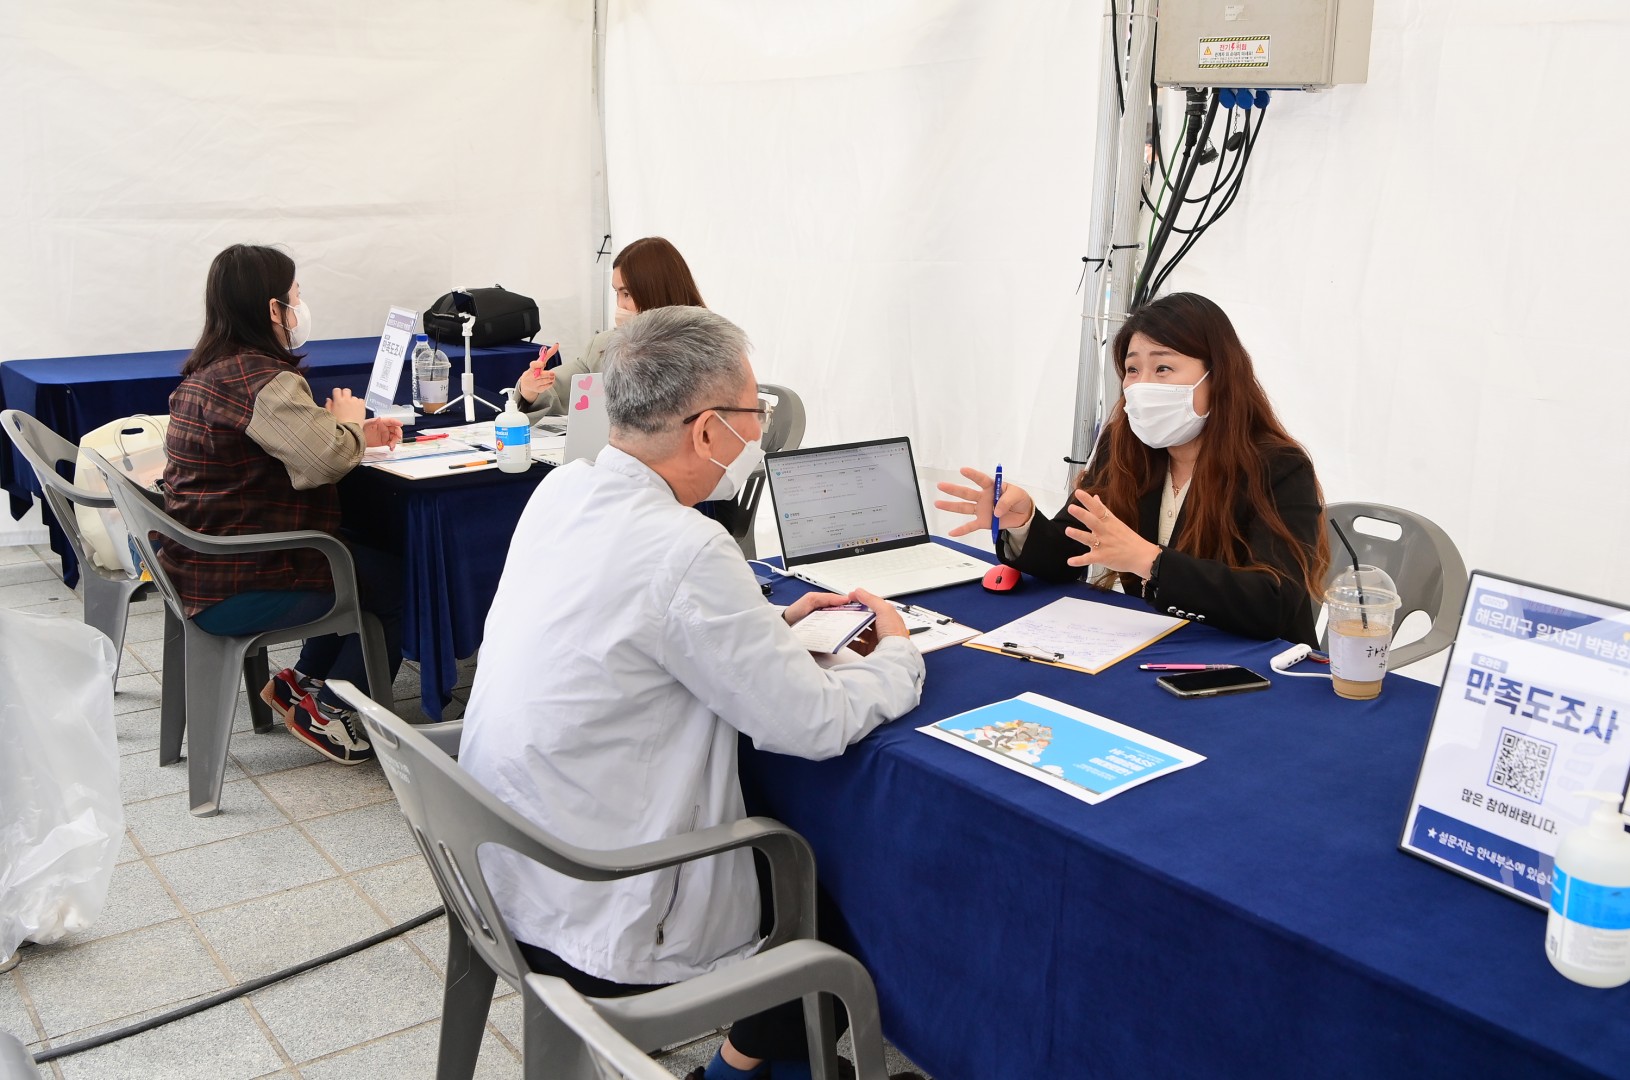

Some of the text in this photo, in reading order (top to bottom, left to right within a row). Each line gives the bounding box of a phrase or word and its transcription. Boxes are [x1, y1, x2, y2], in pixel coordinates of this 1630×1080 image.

[1475, 607, 1533, 635] 해운대구
[1536, 622, 1582, 649] 일자리
[1464, 668, 1619, 744] 만족도조사
[1461, 788, 1558, 835] 많은 참여바랍니다.
[1438, 831, 1475, 856] 설문지는
[1476, 846, 1526, 876] 안내부스에
